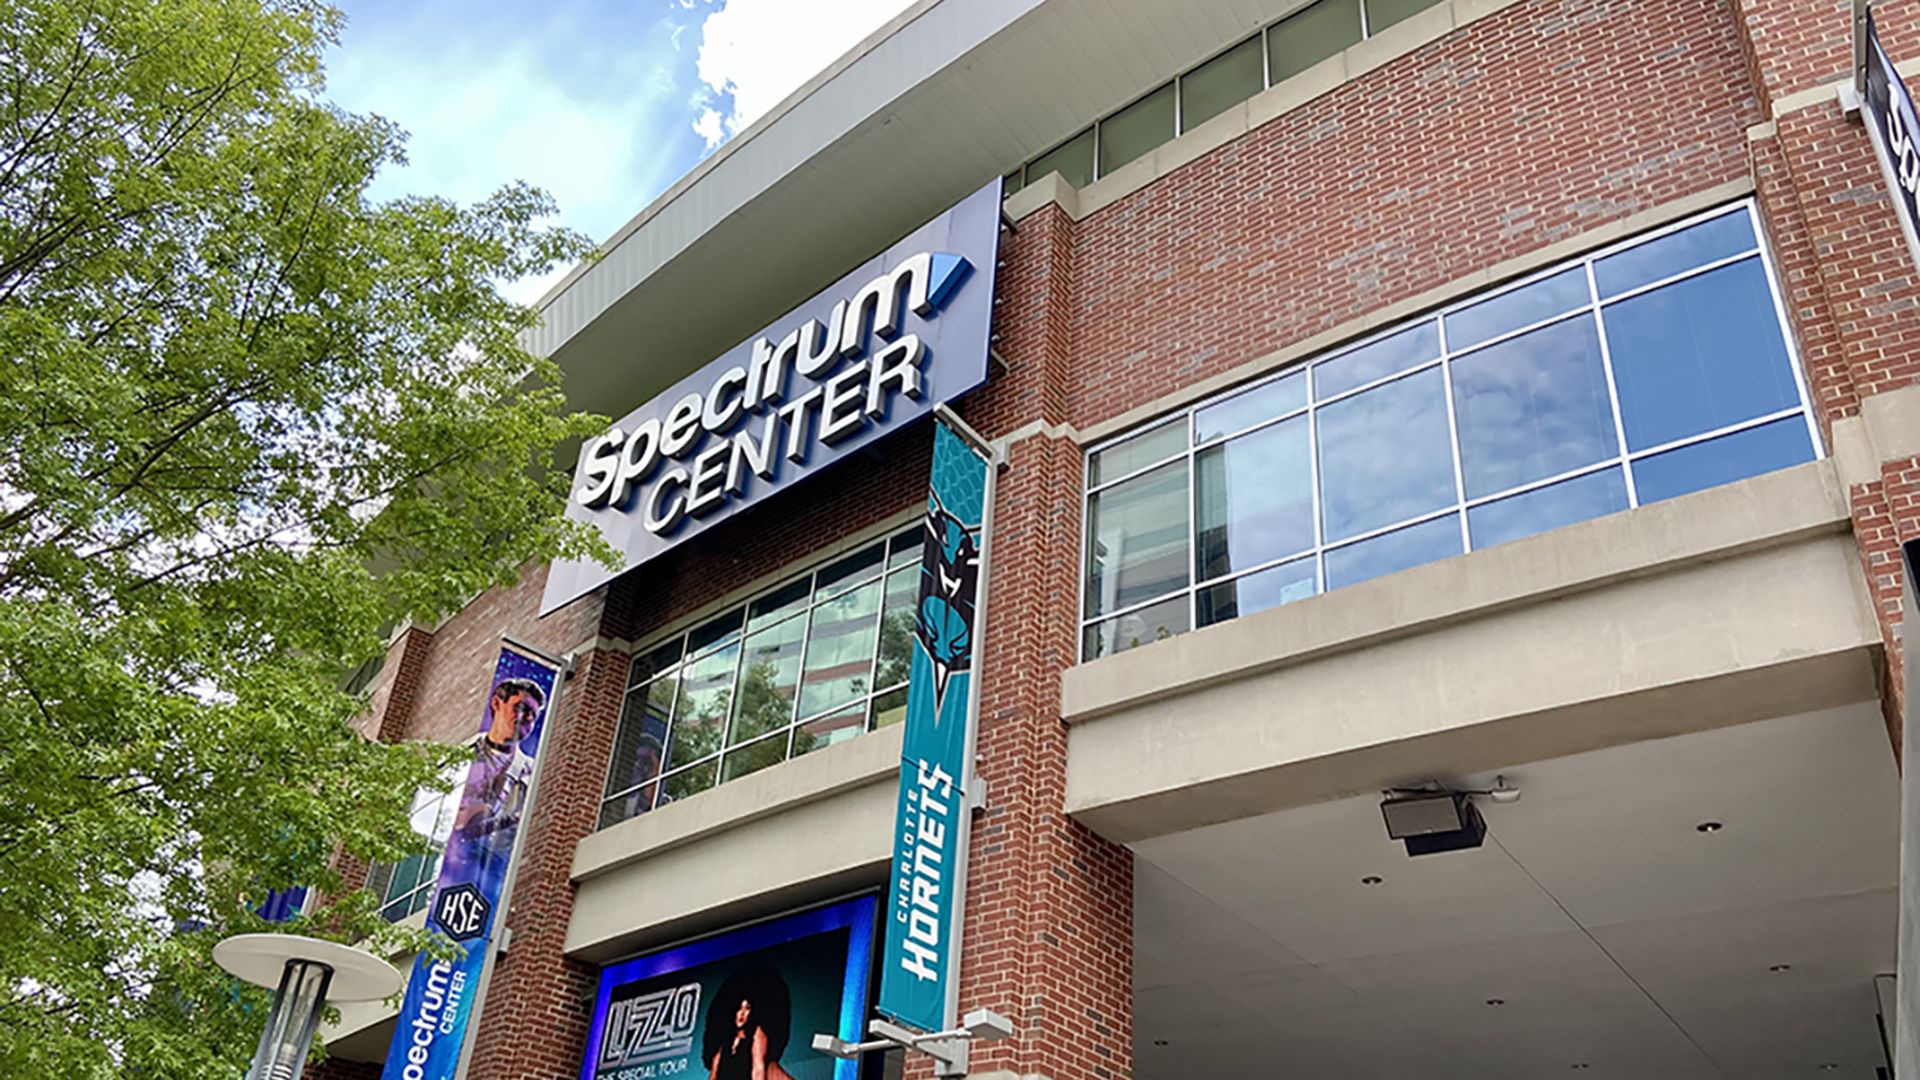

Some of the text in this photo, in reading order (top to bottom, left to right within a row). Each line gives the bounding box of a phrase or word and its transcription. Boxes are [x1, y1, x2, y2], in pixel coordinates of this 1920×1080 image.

[575, 252, 933, 509] Spectrum
[643, 334, 926, 537] CENTER
[441, 891, 484, 934] HSE
[897, 789, 918, 924] CHARLOTTE
[902, 758, 953, 982] HORNETS
[439, 970, 467, 1034] CENTER
[617, 1064, 657, 1080] SPECIAL
[659, 1058, 688, 1077] TOUR
